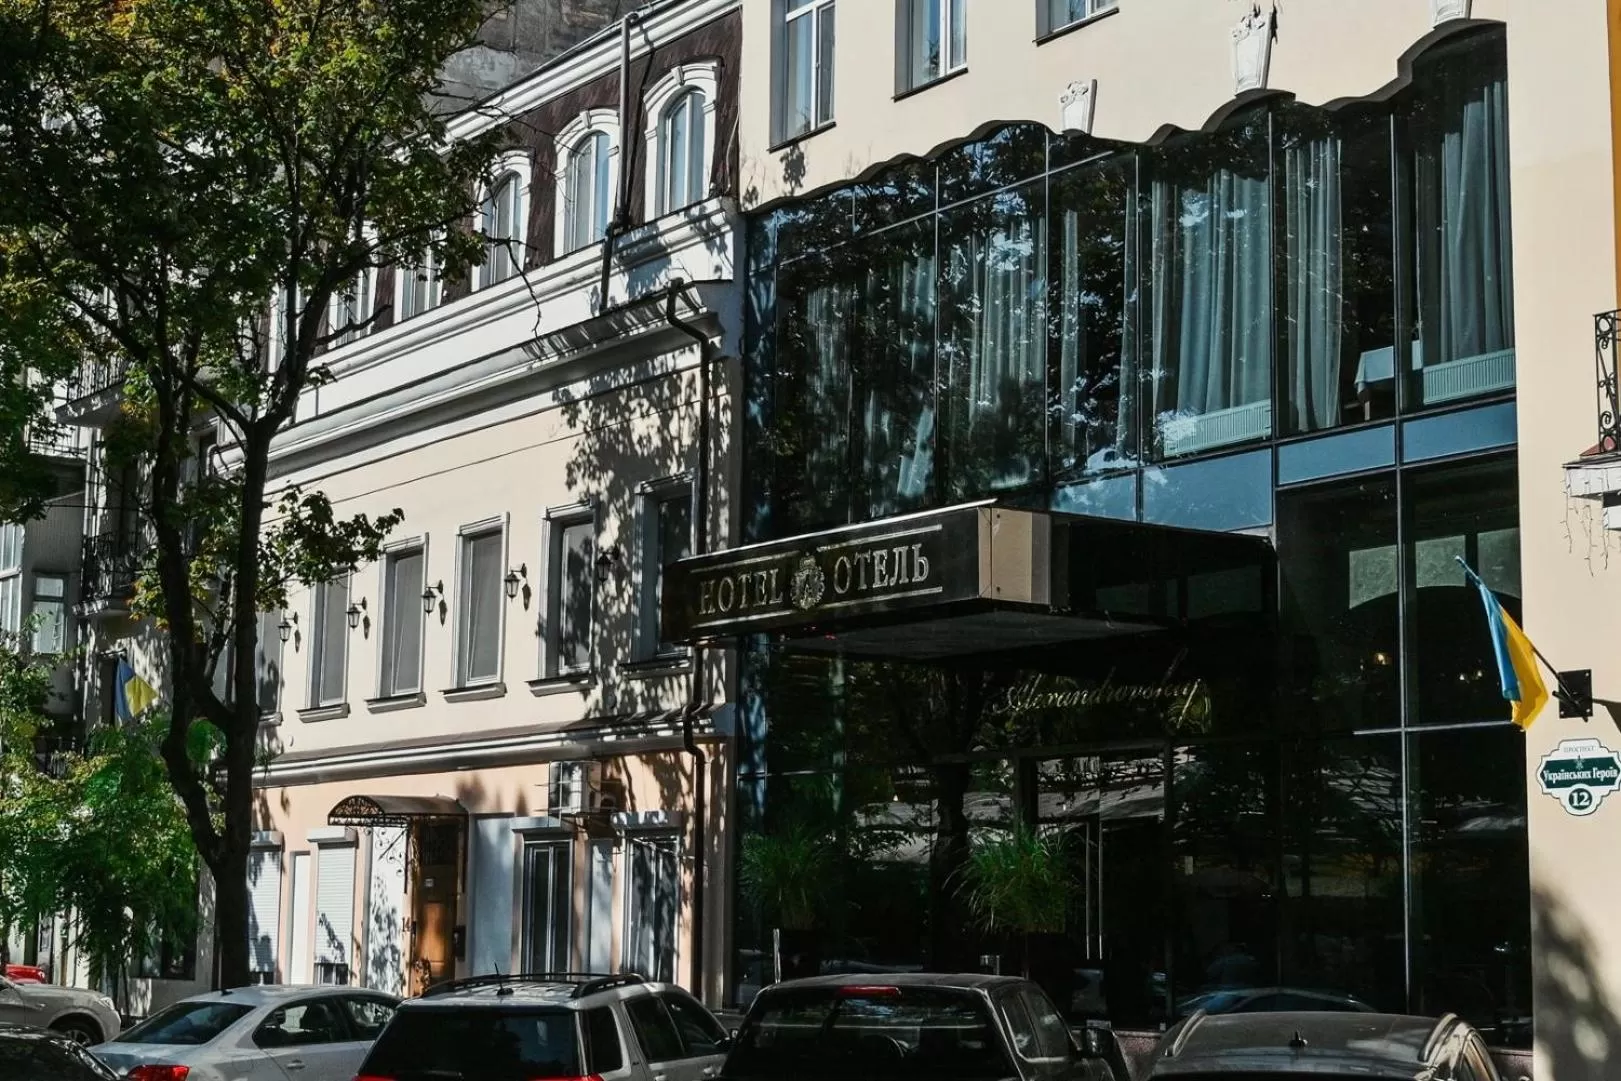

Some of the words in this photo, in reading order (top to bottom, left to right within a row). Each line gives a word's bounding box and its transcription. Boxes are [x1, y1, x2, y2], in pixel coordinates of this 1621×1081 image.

[833, 543, 930, 595] ОТЕЛЬ
[699, 568, 783, 616] HOTEL
[1542, 768, 1591, 784] Українських
[1592, 766, 1618, 782] Героїв
[1571, 791, 1590, 807] 12
